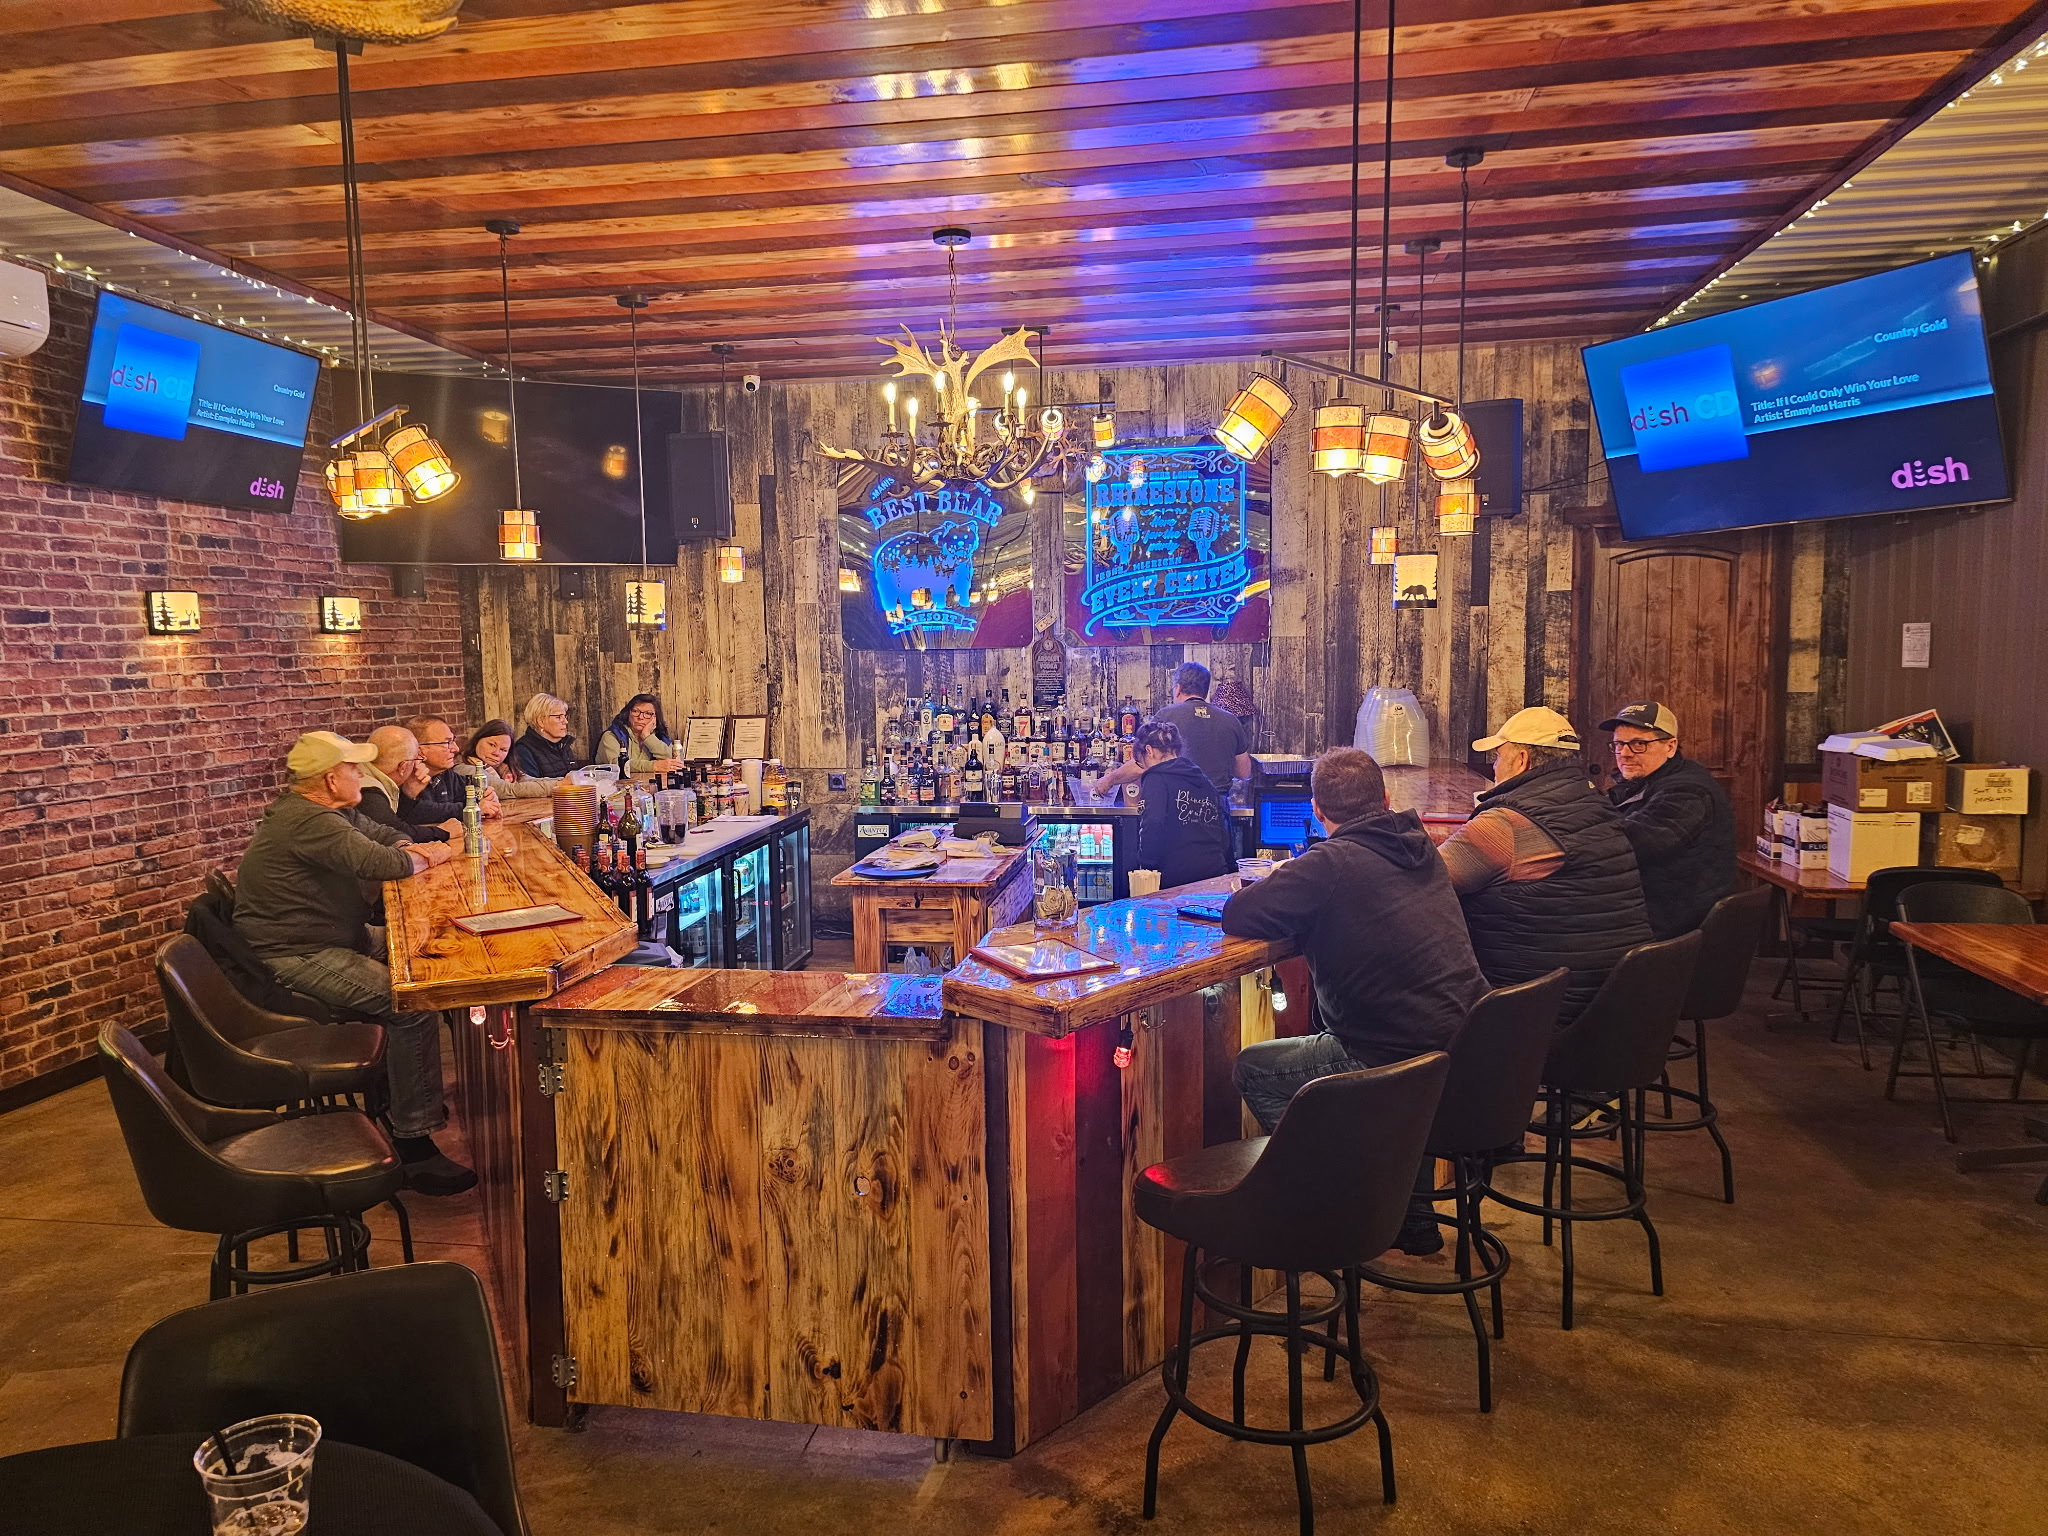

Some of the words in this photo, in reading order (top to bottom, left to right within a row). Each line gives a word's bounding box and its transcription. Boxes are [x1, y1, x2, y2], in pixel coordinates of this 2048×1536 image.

[1874, 327, 1919, 343] Country
[1919, 318, 1949, 334] Gold
[111, 365, 158, 394] dish
[162, 376, 194, 401] CD
[273, 384, 294, 397] Country
[293, 390, 305, 399] Gold
[1750, 400, 1776, 412] Title:
[1776, 397, 1786, 408] If
[1790, 390, 1819, 405] Could
[1819, 386, 1844, 400] Only
[1844, 382, 1867, 395] Win
[1867, 377, 1892, 392] Your
[1893, 373, 1920, 386] Love
[196, 408, 214, 420] Artist:
[214, 412, 239, 425] Emmylou
[239, 418, 256, 429] Harris
[198, 398, 213, 410] Title:
[221, 404, 238, 415] Could
[237, 408, 251, 418] Only
[250, 411, 261, 421] Win
[261, 413, 273, 423] Your
[272, 416, 285, 426] Love
[1632, 401, 1689, 431] dish
[1694, 389, 1738, 420] CD
[1753, 409, 1784, 424] Artist:
[1784, 403, 1829, 419] Emmylou
[1829, 396, 1861, 411] Harris
[1891, 456, 1969, 489] dish
[249, 476, 285, 499] dish
[1096, 478, 1235, 507] RHINESTONE
[866, 491, 929, 530] BEST
[936, 490, 1003, 527] BEAR
[1090, 574, 1158, 614] EVENT
[1164, 555, 1247, 593] CENTER
